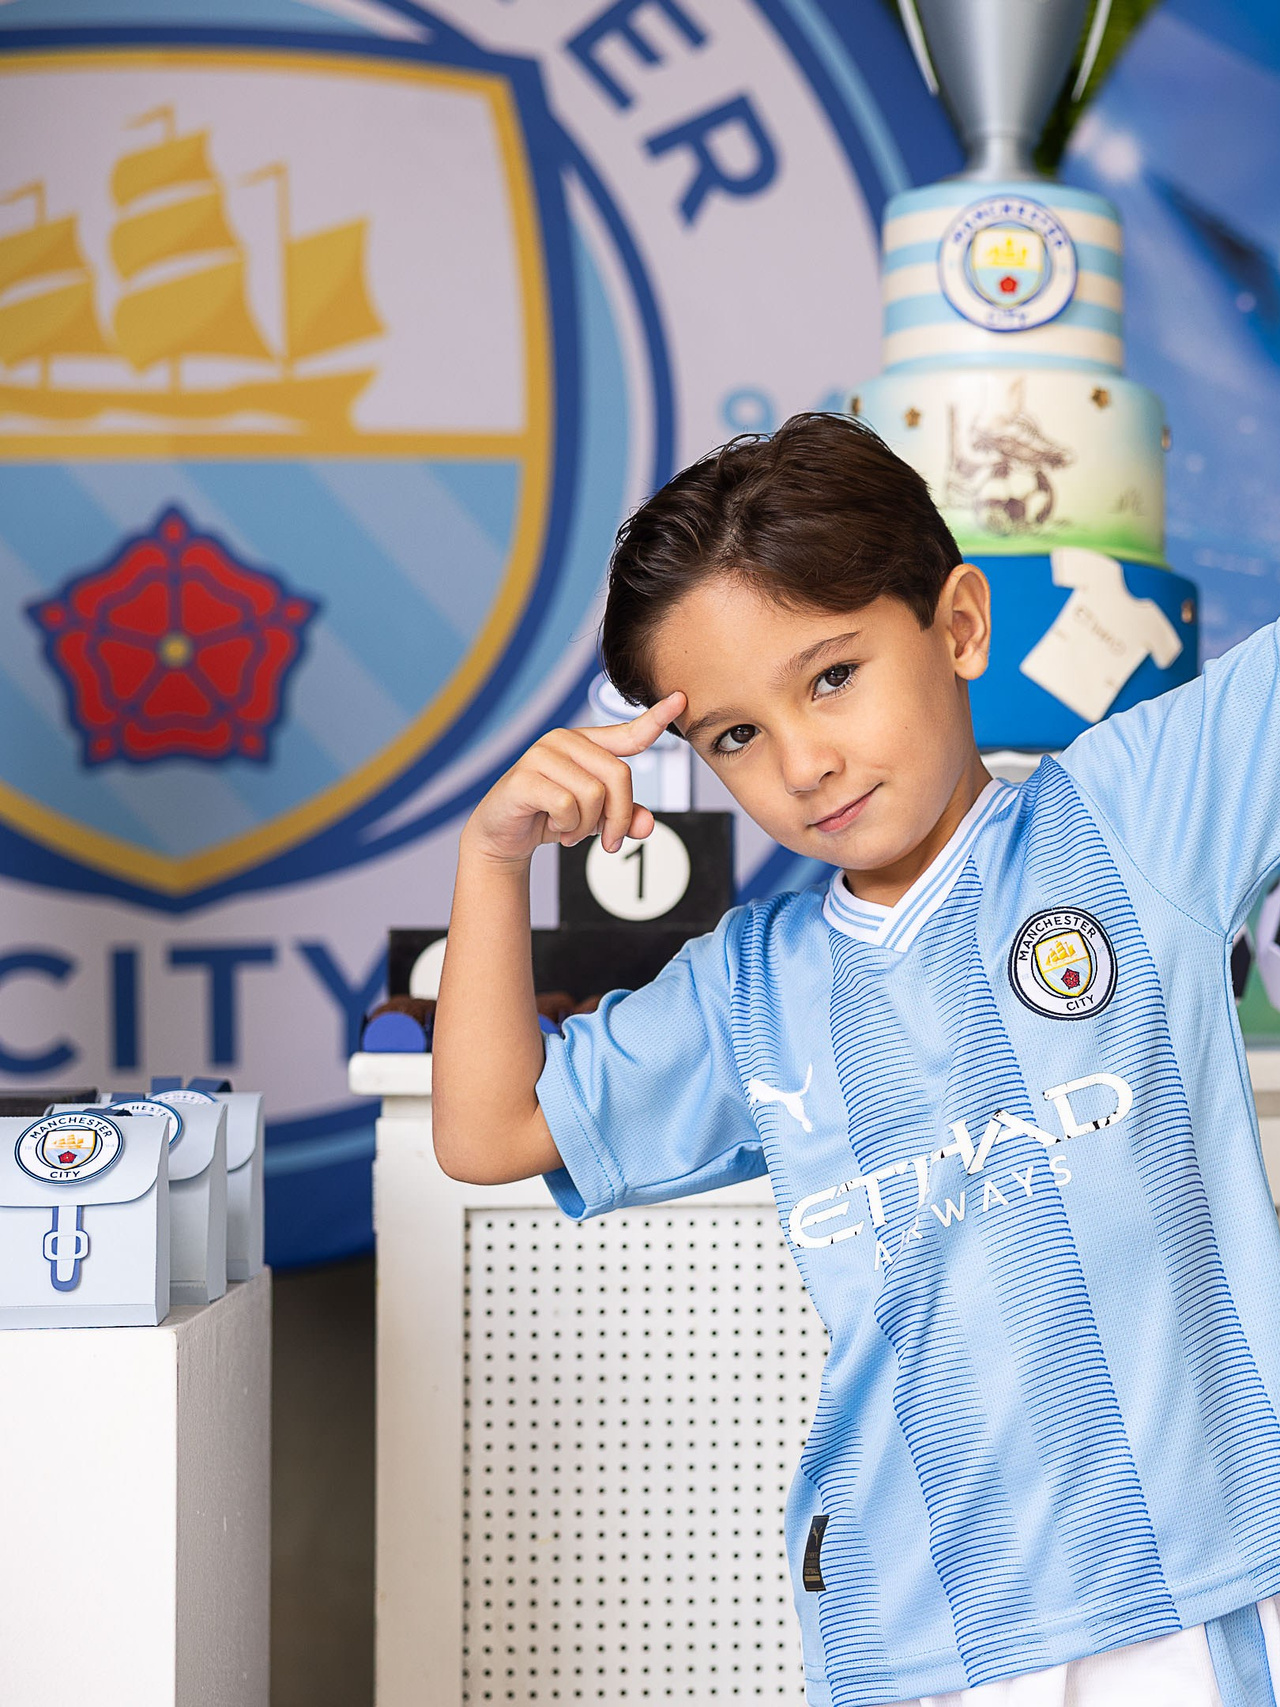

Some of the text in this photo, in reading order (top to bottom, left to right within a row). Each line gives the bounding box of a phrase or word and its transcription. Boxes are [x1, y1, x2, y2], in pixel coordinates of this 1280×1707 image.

[621, 842, 646, 902] 1
[1018, 915, 1097, 961] MANCHESTER
[0, 940, 390, 1079] CITY
[1066, 994, 1094, 1011] CITY
[29, 1116, 113, 1140] MANCHESTER
[49, 1169, 81, 1179] CITY
[788, 1072, 1134, 1249] ETIHAD
